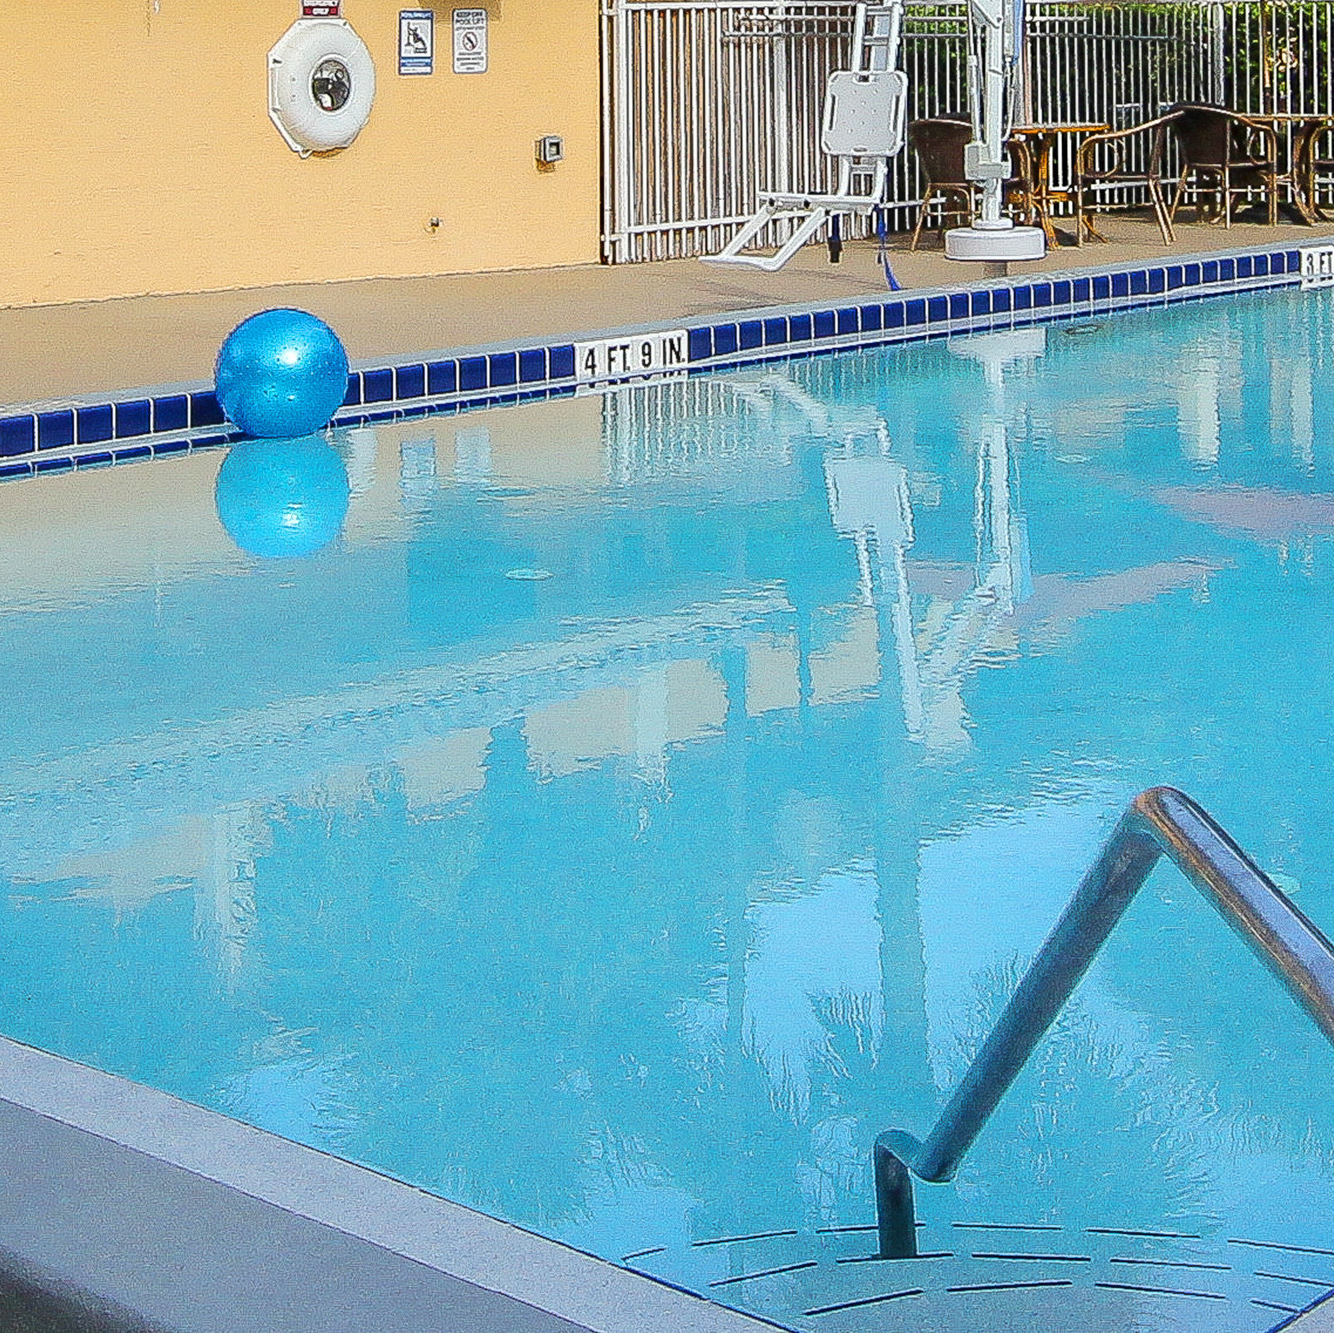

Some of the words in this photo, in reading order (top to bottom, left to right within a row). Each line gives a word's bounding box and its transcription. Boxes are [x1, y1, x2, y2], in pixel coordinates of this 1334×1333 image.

[1306, 252, 1314, 275] 3
[584, 347, 597, 375] 4
[641, 341, 652, 368] 9
[662, 336, 686, 365] IN.
